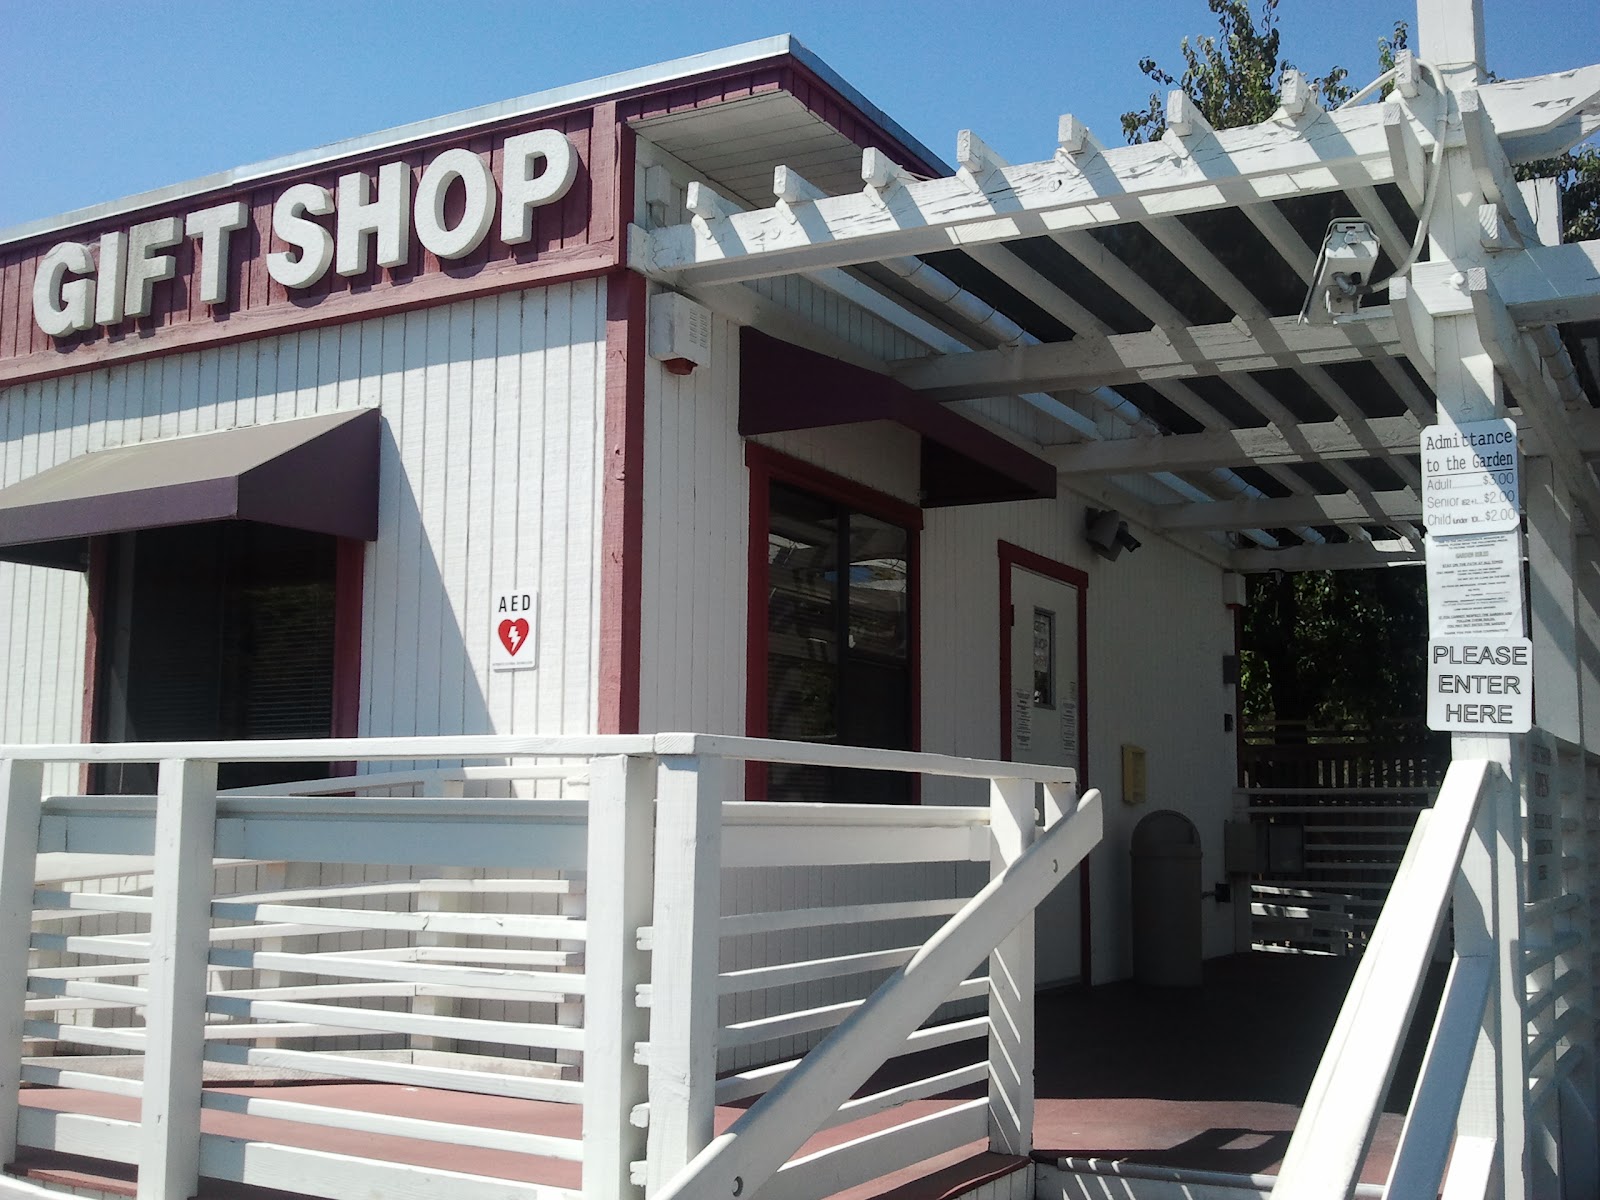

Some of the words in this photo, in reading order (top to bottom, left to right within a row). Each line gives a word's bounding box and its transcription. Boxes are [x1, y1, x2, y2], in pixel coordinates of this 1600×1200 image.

[32, 201, 248, 338] GIFT
[266, 128, 578, 289] SHOP
[1426, 431, 1512, 450] Admittance
[1427, 458, 1440, 472] to
[1446, 455, 1466, 471] the
[1472, 451, 1513, 468] Garden
[1483, 472, 1514, 486] $3.00
[1427, 496, 1459, 508] Senior
[1484, 490, 1515, 503] $2.00
[1427, 513, 1451, 526] Child
[1485, 508, 1515, 521] $2.00
[498, 594, 530, 613] AED
[1433, 645, 1527, 665] PLEASE
[1438, 674, 1521, 694] ENTER
[1446, 703, 1513, 724] HERE
